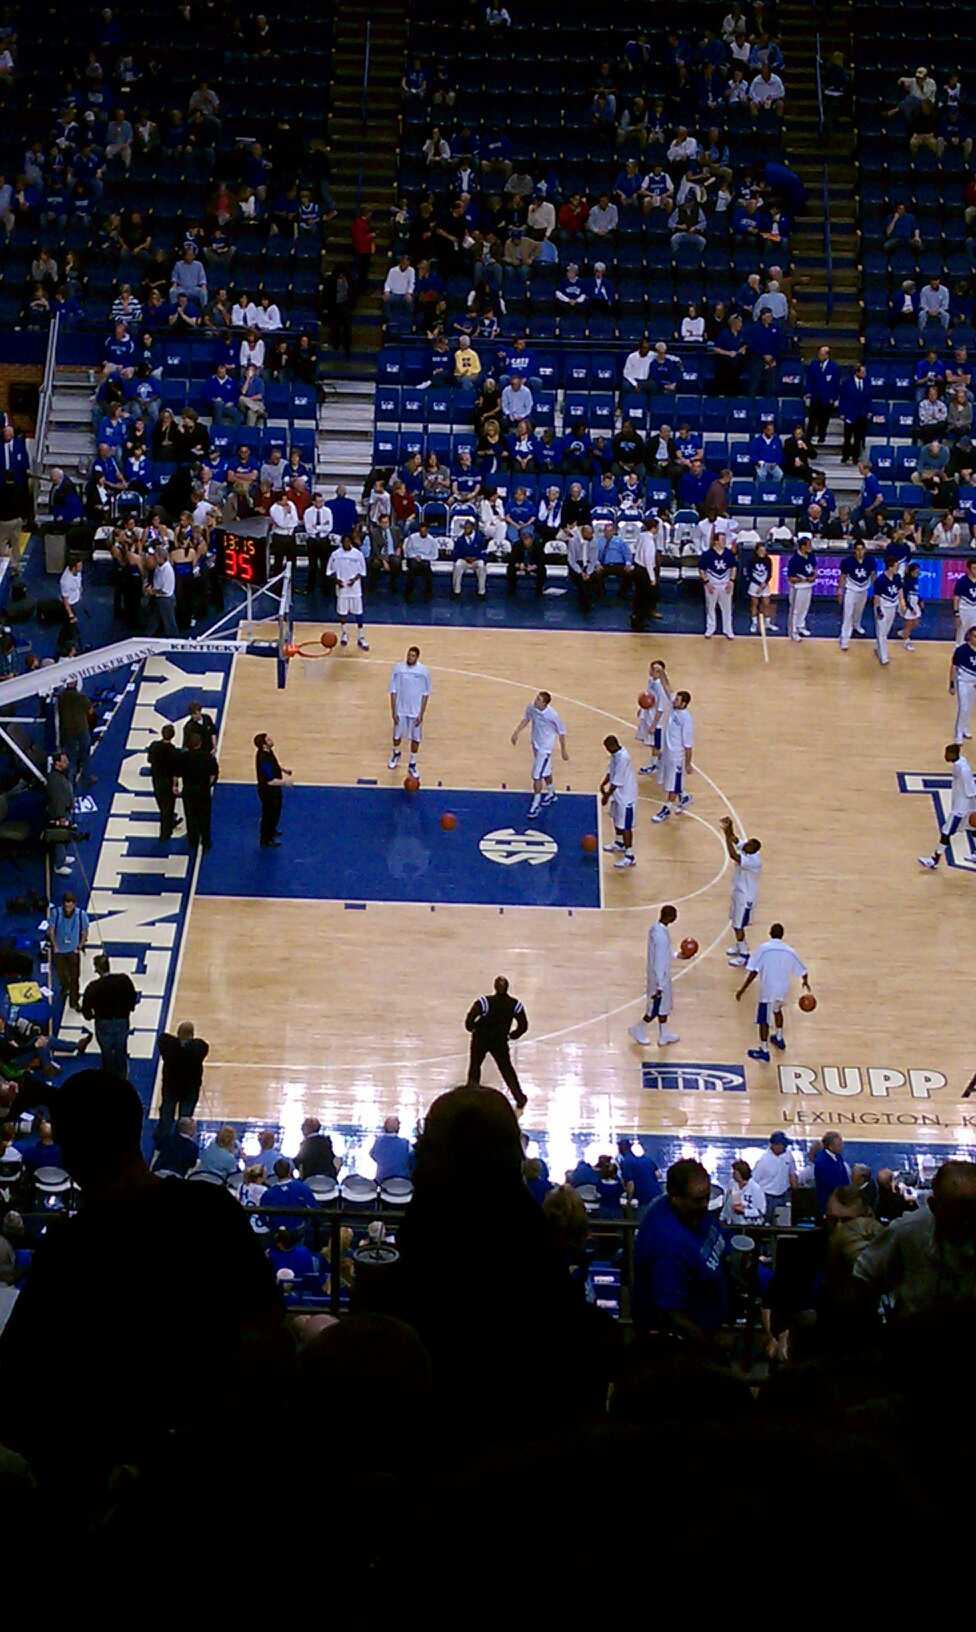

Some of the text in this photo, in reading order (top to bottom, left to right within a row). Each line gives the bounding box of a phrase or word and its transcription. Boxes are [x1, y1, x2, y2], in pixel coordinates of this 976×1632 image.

[225, 549, 253, 580] 35
[125, 647, 156, 662] BANK
[170, 643, 243, 653] KENTUCKY
[777, 1064, 949, 1099] RUPP
[782, 1110, 950, 1129] LEXINGTON,
